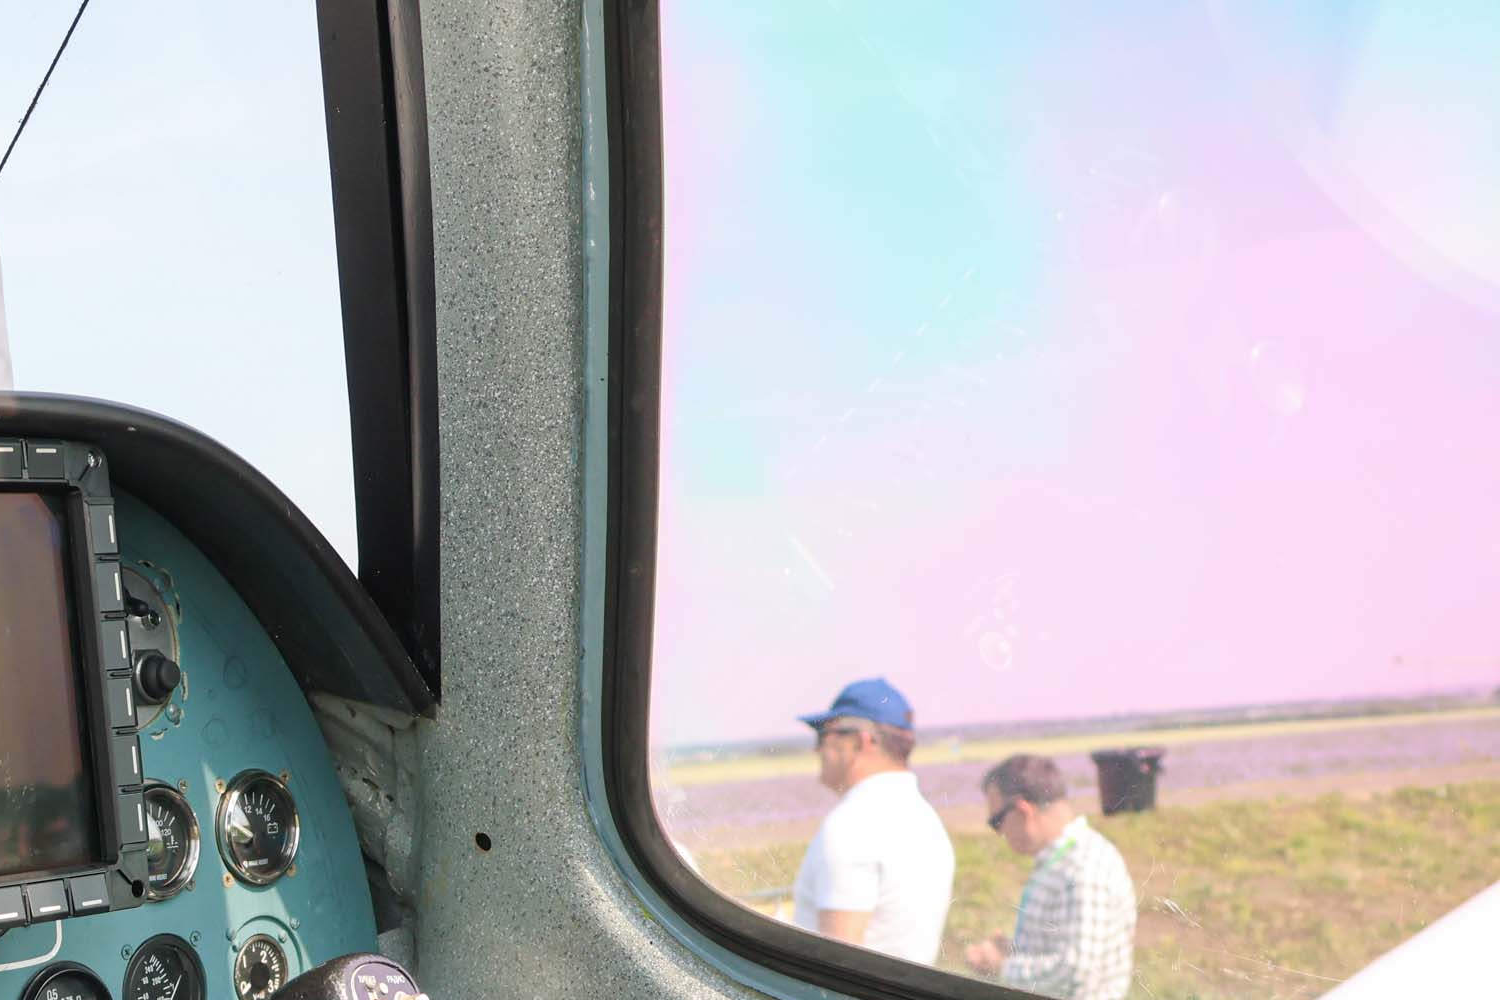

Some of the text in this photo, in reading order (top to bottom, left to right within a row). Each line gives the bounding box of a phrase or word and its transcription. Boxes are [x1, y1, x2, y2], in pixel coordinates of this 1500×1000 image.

[243, 806, 252, 814] 12
[255, 807, 263, 815] 14
[260, 951, 268, 964] 2
[267, 979, 274, 993] 3
